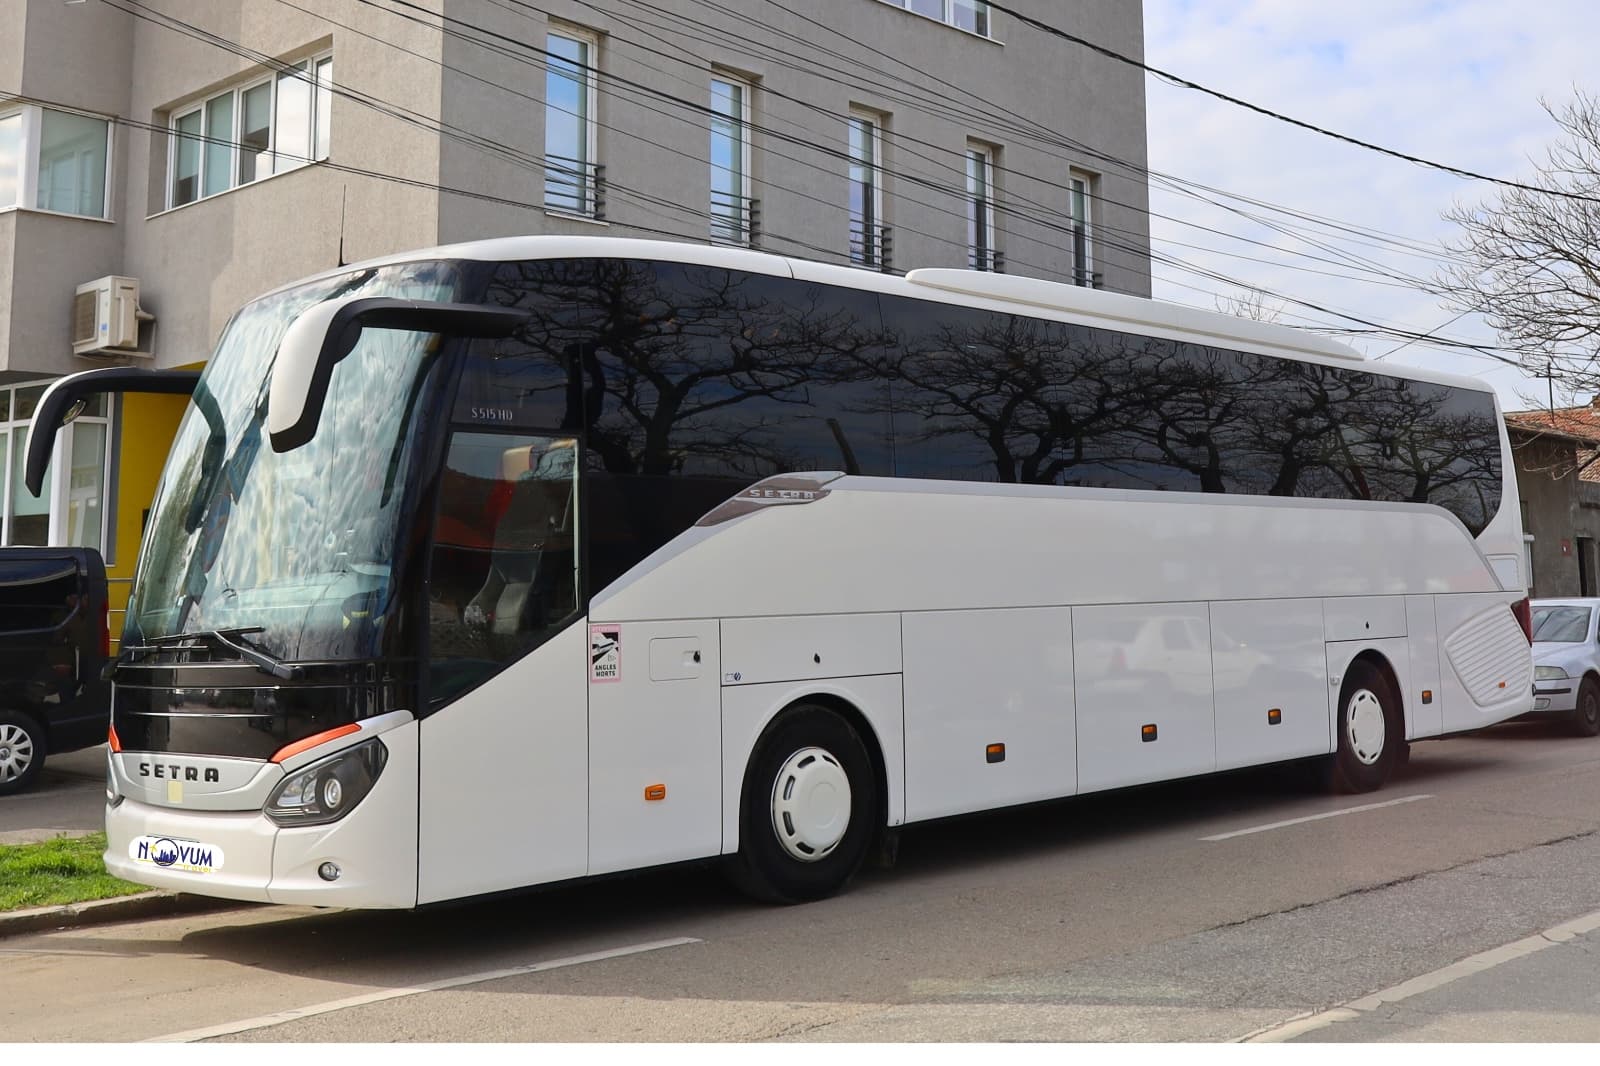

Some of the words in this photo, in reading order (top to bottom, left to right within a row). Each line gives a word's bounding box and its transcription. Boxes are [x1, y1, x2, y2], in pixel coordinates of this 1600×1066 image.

[471, 407, 478, 418] S
[498, 409, 513, 421] HD
[749, 489, 815, 499] SETRA
[139, 763, 219, 783] SETRA
